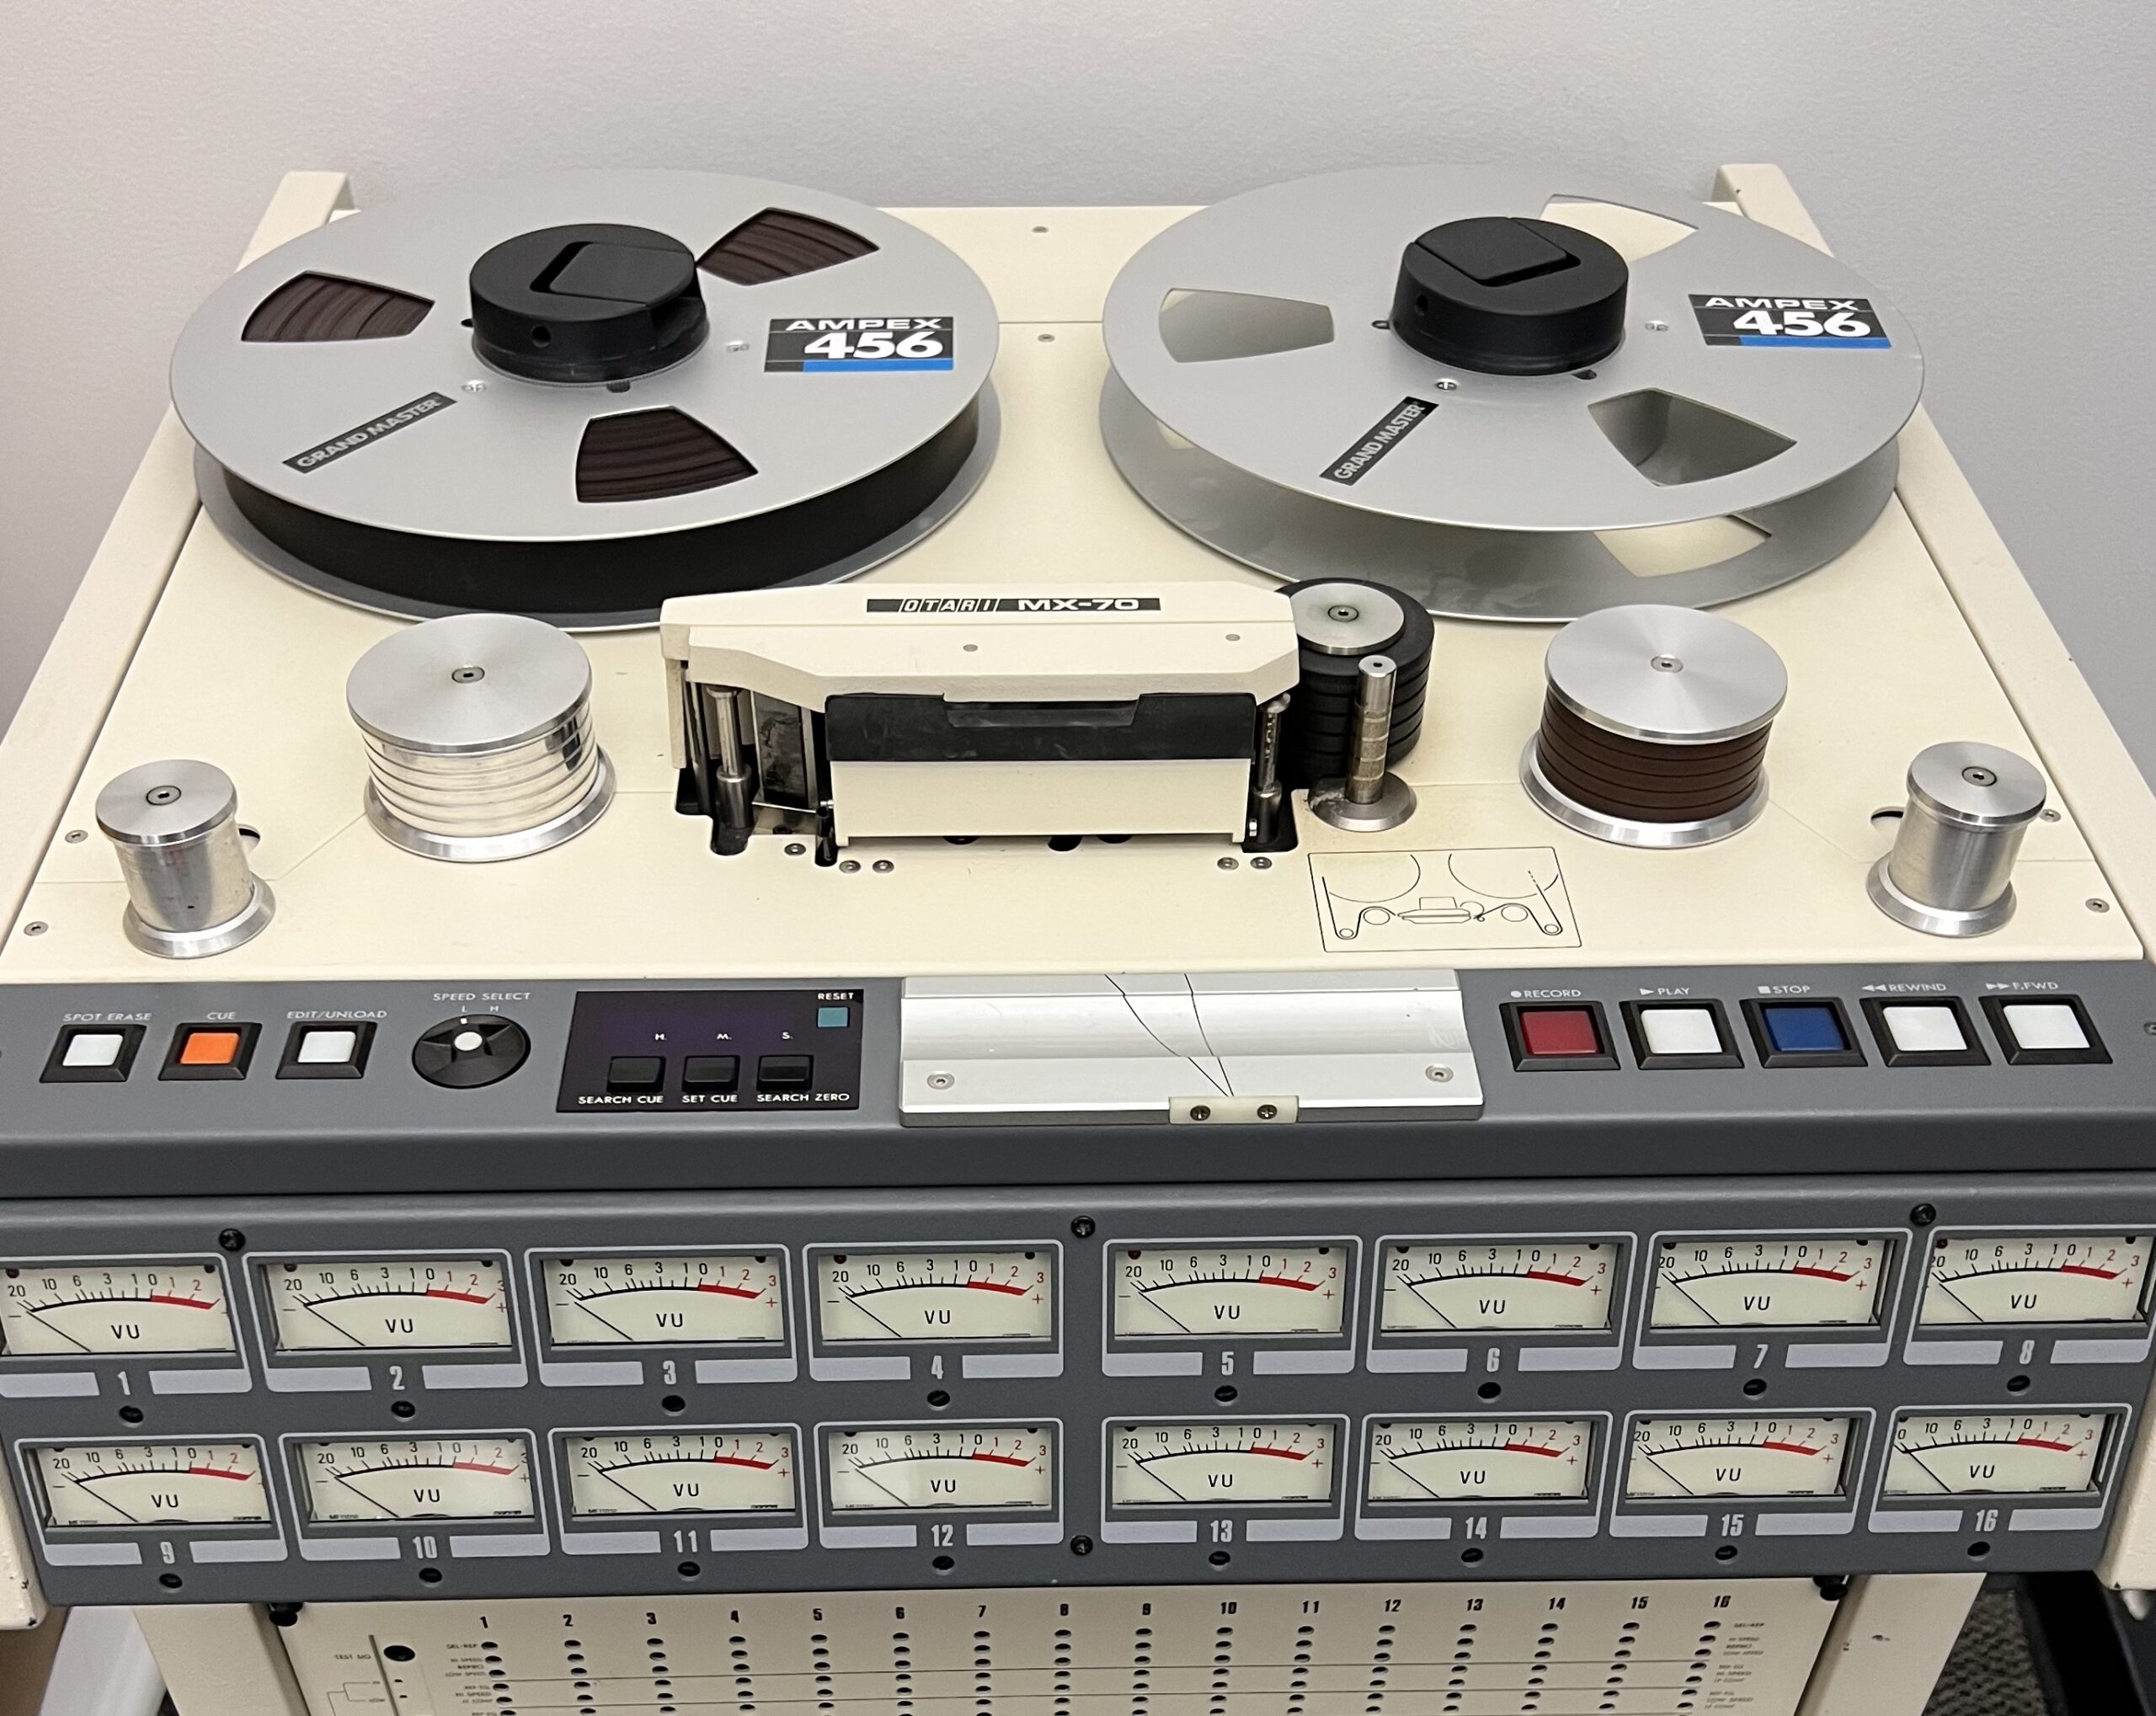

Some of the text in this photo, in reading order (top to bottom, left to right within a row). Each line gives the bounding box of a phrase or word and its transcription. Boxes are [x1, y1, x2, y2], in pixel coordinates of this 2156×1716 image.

[1705, 297, 1859, 311] AMPEX
[786, 318, 942, 331] AMPEX
[1733, 310, 1870, 337] 456
[804, 331, 943, 359] 456
[296, 399, 442, 467] GRAND MASTER
[1334, 403, 1426, 479] GRAND MASTER
[901, 599, 1139, 611] OTARI MX-70
[1524, 989, 1581, 998] RECORD
[1773, 985, 1810, 994] STOP
[287, 1010, 387, 1019] EDIT/UNLOAD
[1392, 1259, 1409, 1271] 20
[1428, 1253, 1442, 1265] 10
[1459, 1250, 1466, 1261] 6
[1488, 1248, 1497, 1260] 3
[1532, 1250, 1540, 1261] 0
[1573, 1256, 1581, 1267] 2
[1598, 1263, 1606, 1274] 3
[1966, 1249, 1978, 1260] 10
[1995, 1245, 2004, 1256] 6
[2025, 1243, 2033, 1255] 3
[2068, 1244, 2076, 1255] 0
[2107, 1250, 2116, 1260] 2
[2131, 1255, 2140, 1266] 3
[832, 1271, 849, 1282] 20
[867, 1264, 880, 1276] 10
[897, 1261, 905, 1272] 6
[926, 1259, 933, 1271] 3
[969, 1260, 977, 1272] 0
[1011, 1266, 1018, 1276] 2
[1037, 1272, 1043, 1283] 3
[8, 1285, 25, 1297] 20
[42, 1278, 56, 1290] 10
[73, 1275, 81, 1287] 6
[103, 1273, 111, 1284] 3
[148, 1273, 157, 1286] 0
[193, 1279, 201, 1291] 2
[1214, 1305, 1240, 1319] VU
[1480, 1300, 1505, 1314] VU
[1744, 1296, 1770, 1310] VU
[2011, 1294, 2036, 1308] VU
[385, 1319, 413, 1333] VU
[656, 1314, 682, 1327] VU
[925, 1310, 950, 1324] VU
[110, 1324, 140, 1339] VU
[1222, 1351, 1234, 1375] 5
[1487, 1348, 1500, 1372] 6
[1754, 1344, 1768, 1368] 7
[2020, 1340, 2035, 1364] 8
[390, 1366, 405, 1390] 2
[663, 1361, 676, 1384] 3
[931, 1356, 943, 1379] 4
[118, 1372, 131, 1395] 1
[1123, 1438, 1138, 1449] 20
[1155, 1431, 1168, 1442] 10
[1184, 1429, 1192, 1439] 6
[1213, 1426, 1219, 1437] 3
[1253, 1427, 1261, 1438] 0
[1294, 1432, 1300, 1443] 2
[1318, 1438, 1324, 1448] 3
[1634, 1431, 1650, 1442] 20
[1669, 1425, 1682, 1436] 10
[1698, 1422, 1706, 1433] 6
[1727, 1421, 1735, 1431] 3
[1769, 1422, 1776, 1433] 0
[1807, 1428, 1815, 1438] 2
[1831, 1434, 1838, 1444] 3
[53, 1458, 70, 1469] 20
[86, 1452, 100, 1463] 10
[115, 1449, 123, 1459] 6
[144, 1447, 152, 1458] 3
[187, 1447, 196, 1458] 0
[230, 1452, 238, 1463] 2
[581, 1447, 597, 1458] 20
[614, 1441, 627, 1452] 10
[643, 1438, 651, 1448] 6
[673, 1436, 680, 1447] 3
[714, 1436, 723, 1447] 0
[756, 1442, 763, 1452] 2
[782, 1447, 788, 1458] 3
[1209, 1474, 1232, 1487] VU
[1460, 1470, 1485, 1484] VU
[1716, 1468, 1741, 1481] VU
[1971, 1465, 1994, 1478] VU
[414, 1490, 440, 1502] VU
[673, 1484, 699, 1496] VU
[931, 1479, 955, 1493] VU
[152, 1495, 179, 1508] VU
[1210, 1520, 1232, 1543] 13
[1465, 1517, 1486, 1539] 14
[1721, 1514, 1744, 1536] 15
[1976, 1510, 1998, 1532] 16
[674, 1530, 697, 1553] 11
[931, 1525, 953, 1547] 12
[160, 1542, 175, 1564] 9
[413, 1536, 437, 1559] 10
[480, 1596, 1731, 1628] 1 2 3 4 5 6 7 8 9 10 11 12 13 14 15 16
